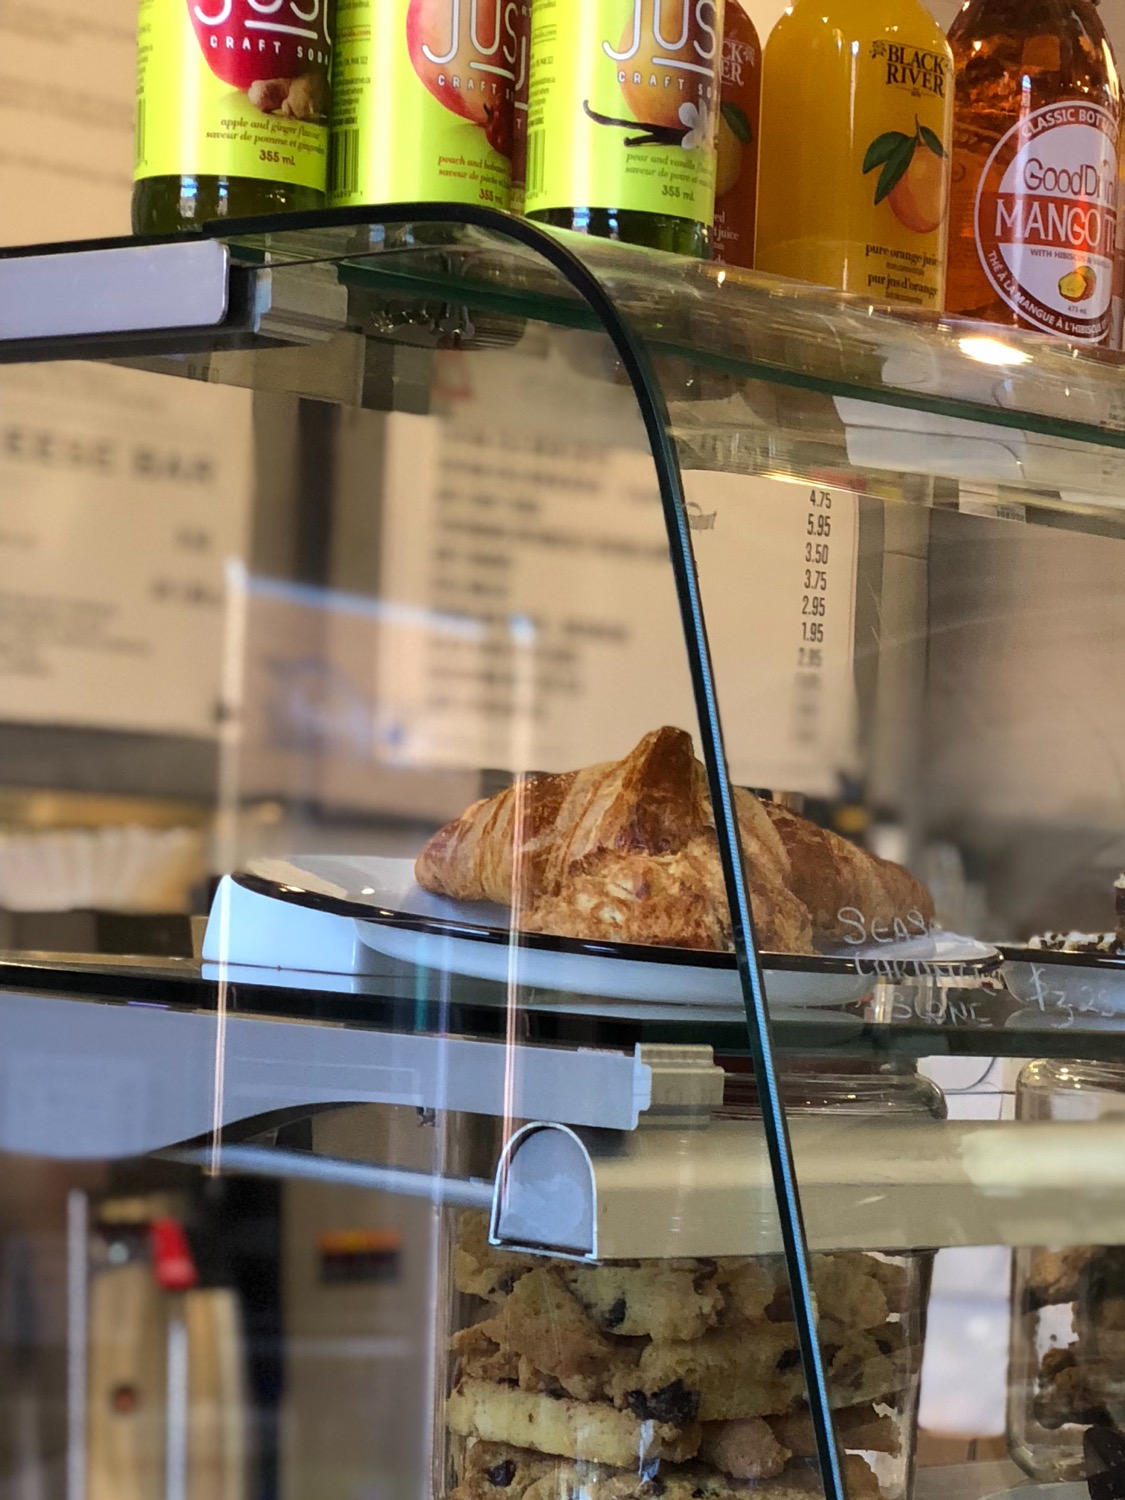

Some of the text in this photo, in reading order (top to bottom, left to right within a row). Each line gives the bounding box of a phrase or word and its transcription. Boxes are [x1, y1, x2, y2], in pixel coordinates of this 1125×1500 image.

[210, 35, 282, 54] CRAFT
[888, 44, 945, 76] BLACK
[437, 74, 498, 96] CRAFT
[618, 70, 684, 91] CRAFT
[886, 62, 945, 99] RIVER
[220, 117, 249, 130] apple
[250, 120, 270, 130] and
[271, 124, 297, 136] ginger
[1021, 109, 1077, 138] CLASSIC
[206, 130, 237, 140] saveur
[239, 131, 252, 141] de
[253, 134, 287, 146] pomme
[259, 149, 279, 162] 355
[438, 155, 466, 167] peach
[467, 159, 483, 168] and
[626, 153, 648, 164] pear
[650, 155, 669, 166] and
[438, 169, 467, 179] saveur
[469, 170, 480, 180] de
[625, 166, 656, 177] saveur
[657, 168, 669, 178] de
[479, 188, 494, 202] 355
[661, 184, 681, 198] 355
[994, 199, 1101, 246] MANGO
[717, 226, 740, 242] juice
[865, 244, 889, 257] pure
[889, 250, 922, 266] orange
[1030, 248, 1053, 257] WITH
[867, 273, 886, 287] pur
[886, 273, 900, 290] jus
[1013, 290, 1056, 326] MANGUE
[809, 489, 832, 510] 4.75
[806, 512, 831, 538] 5.95
[804, 541, 829, 565] 3.50
[803, 568, 827, 591] 3.75
[801, 595, 826, 617] 2.95
[801, 621, 824, 644] 1.95
